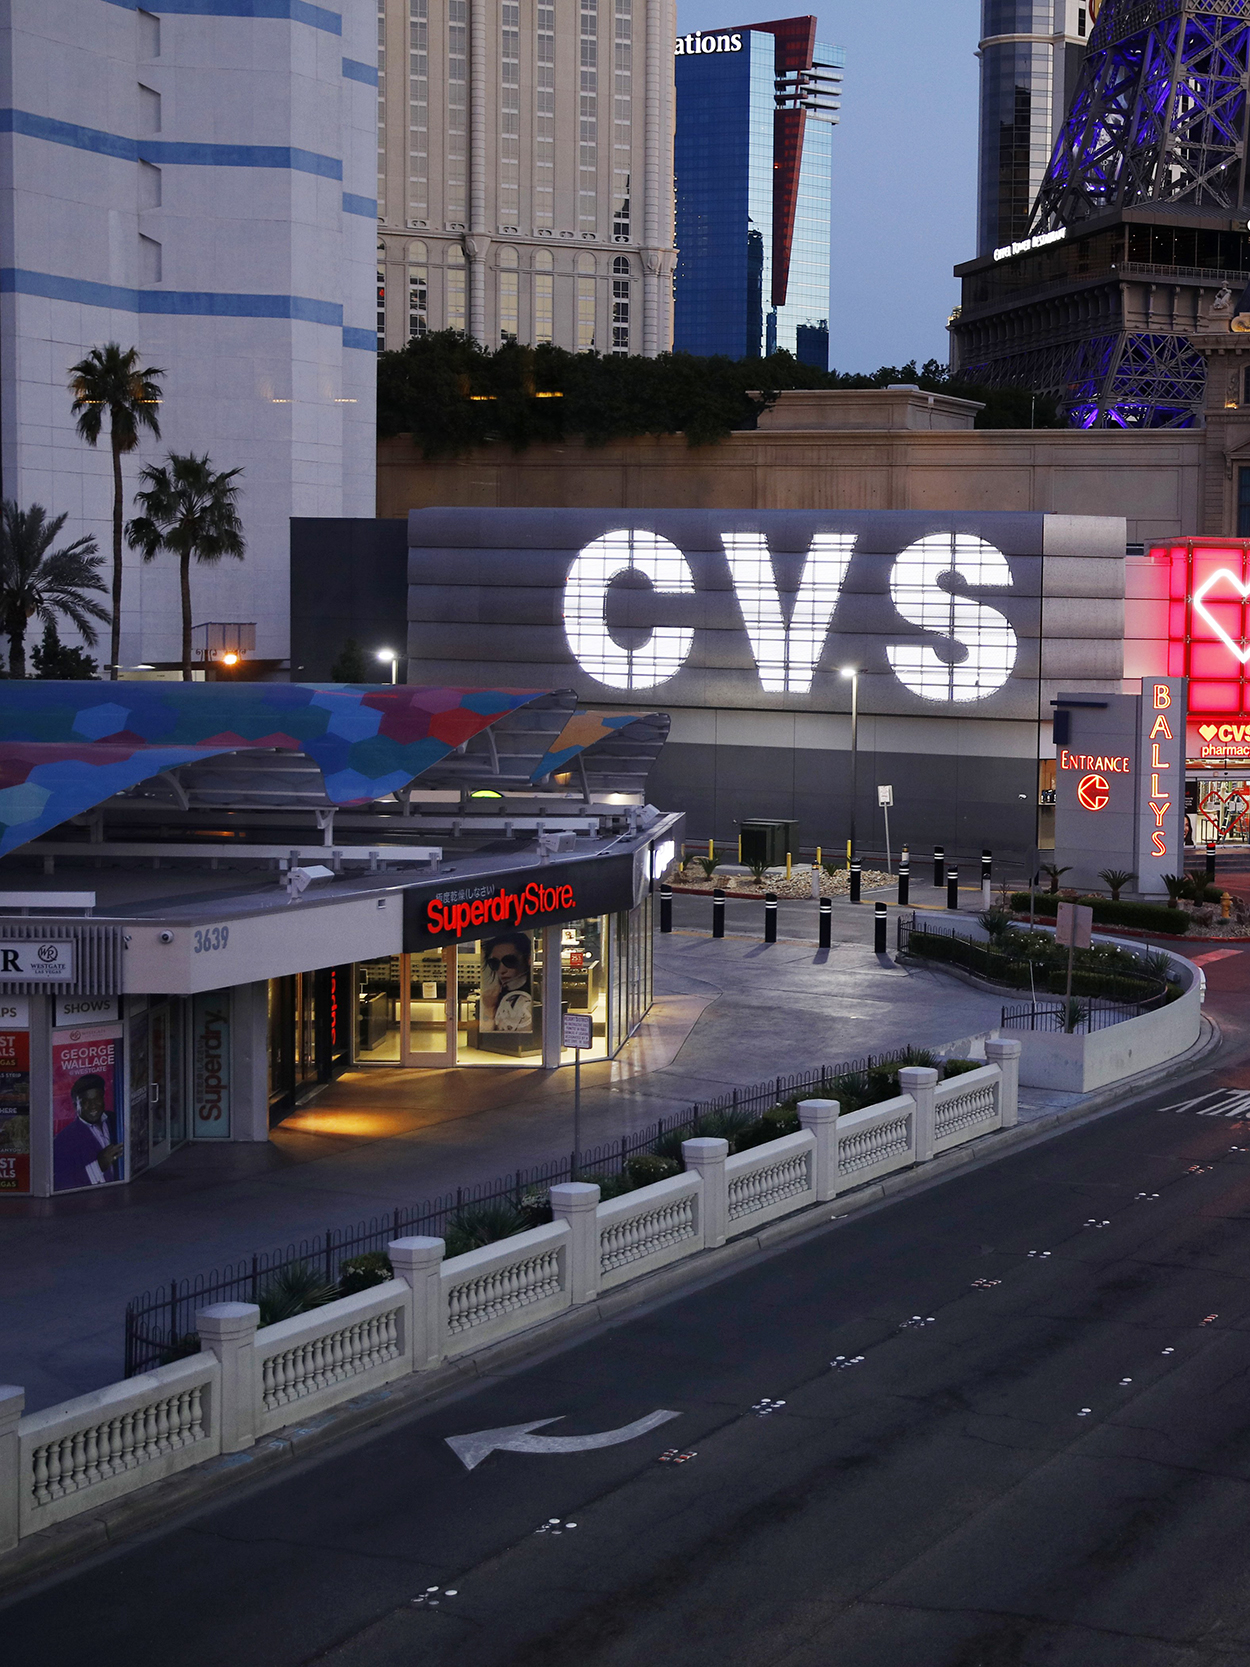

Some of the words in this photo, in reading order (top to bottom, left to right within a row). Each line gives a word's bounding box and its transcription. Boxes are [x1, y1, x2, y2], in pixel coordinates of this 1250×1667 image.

[563, 527, 1019, 702] CVS
[1060, 749, 1131, 773] ENTRANCE
[1148, 683, 1174, 858] BALLYS
[194, 926, 229, 954] 3639
[0, 1007, 17, 1018] PS
[63, 1001, 111, 1016] SHOWS
[61, 1044, 115, 1060] GEORGE
[61, 1055, 115, 1070] WALLACE
